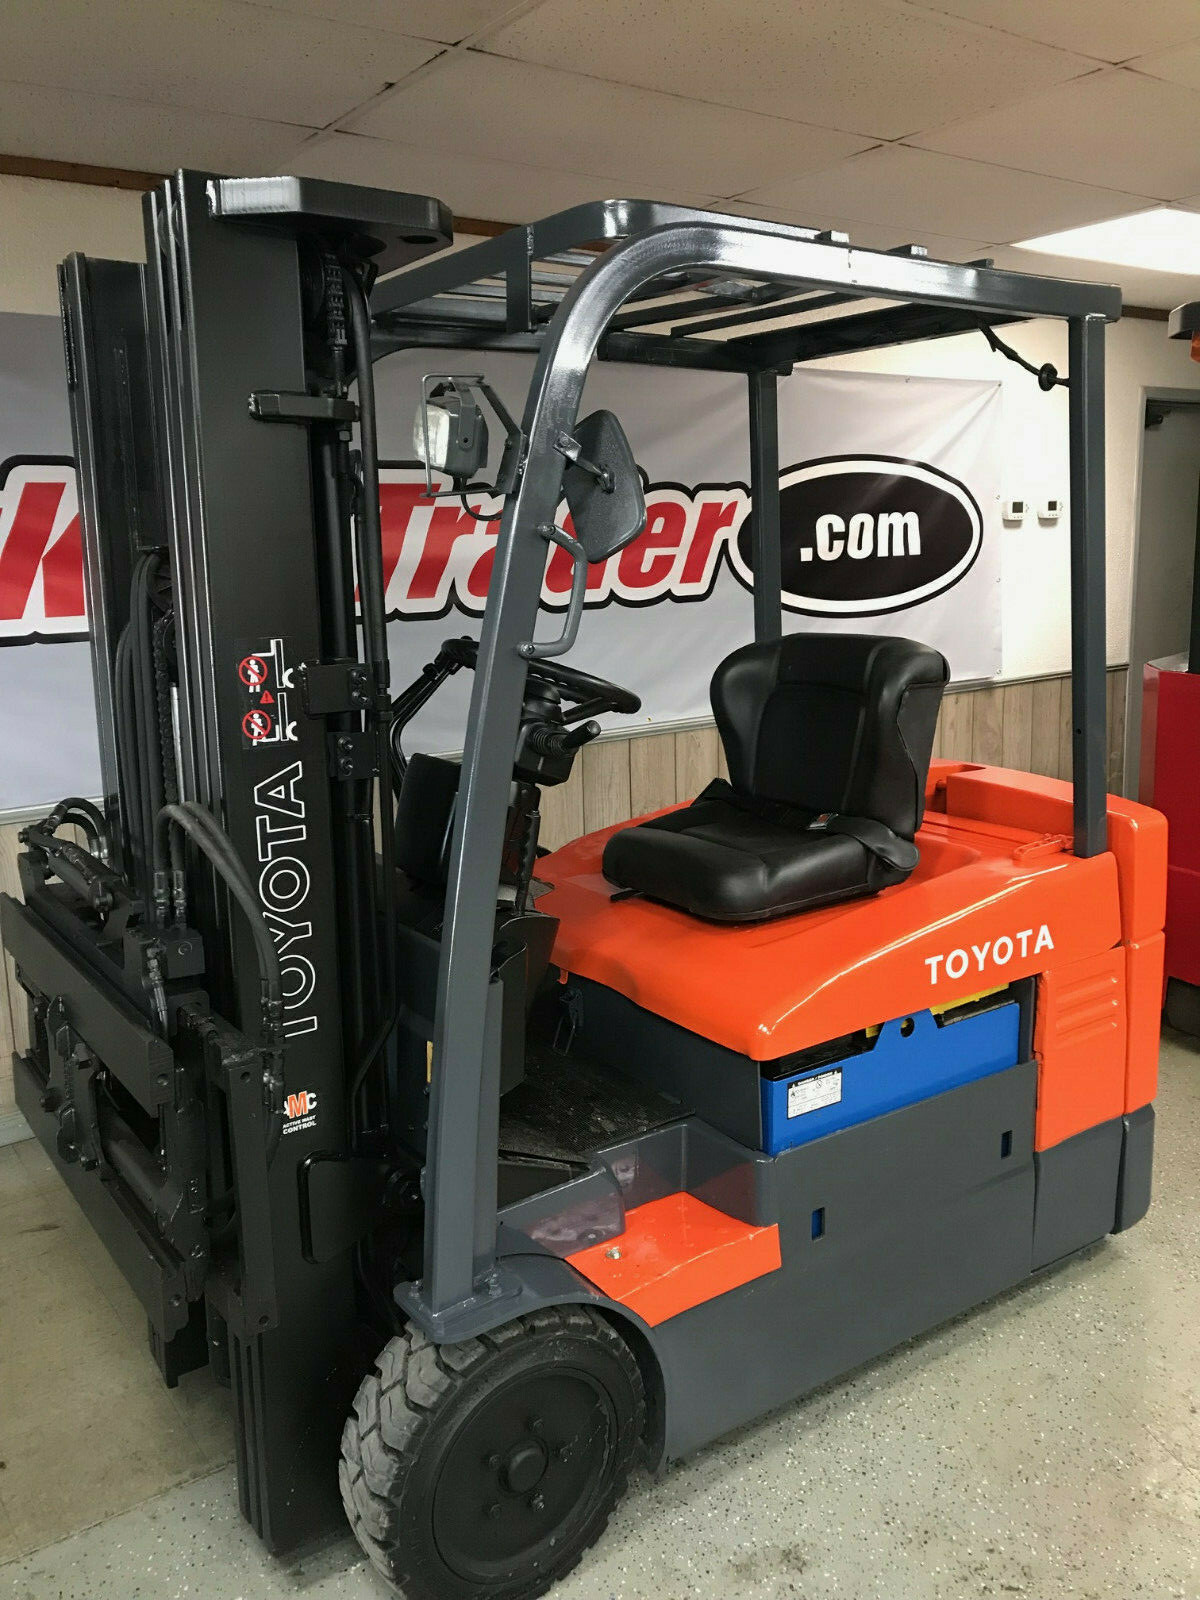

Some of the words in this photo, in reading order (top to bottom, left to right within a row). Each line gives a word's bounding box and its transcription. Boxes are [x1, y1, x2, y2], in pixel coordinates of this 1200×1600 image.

[800, 511, 922, 562] .com
[924, 924, 1055, 985] TOYOTA
[282, 1121, 317, 1135] CONTROL
